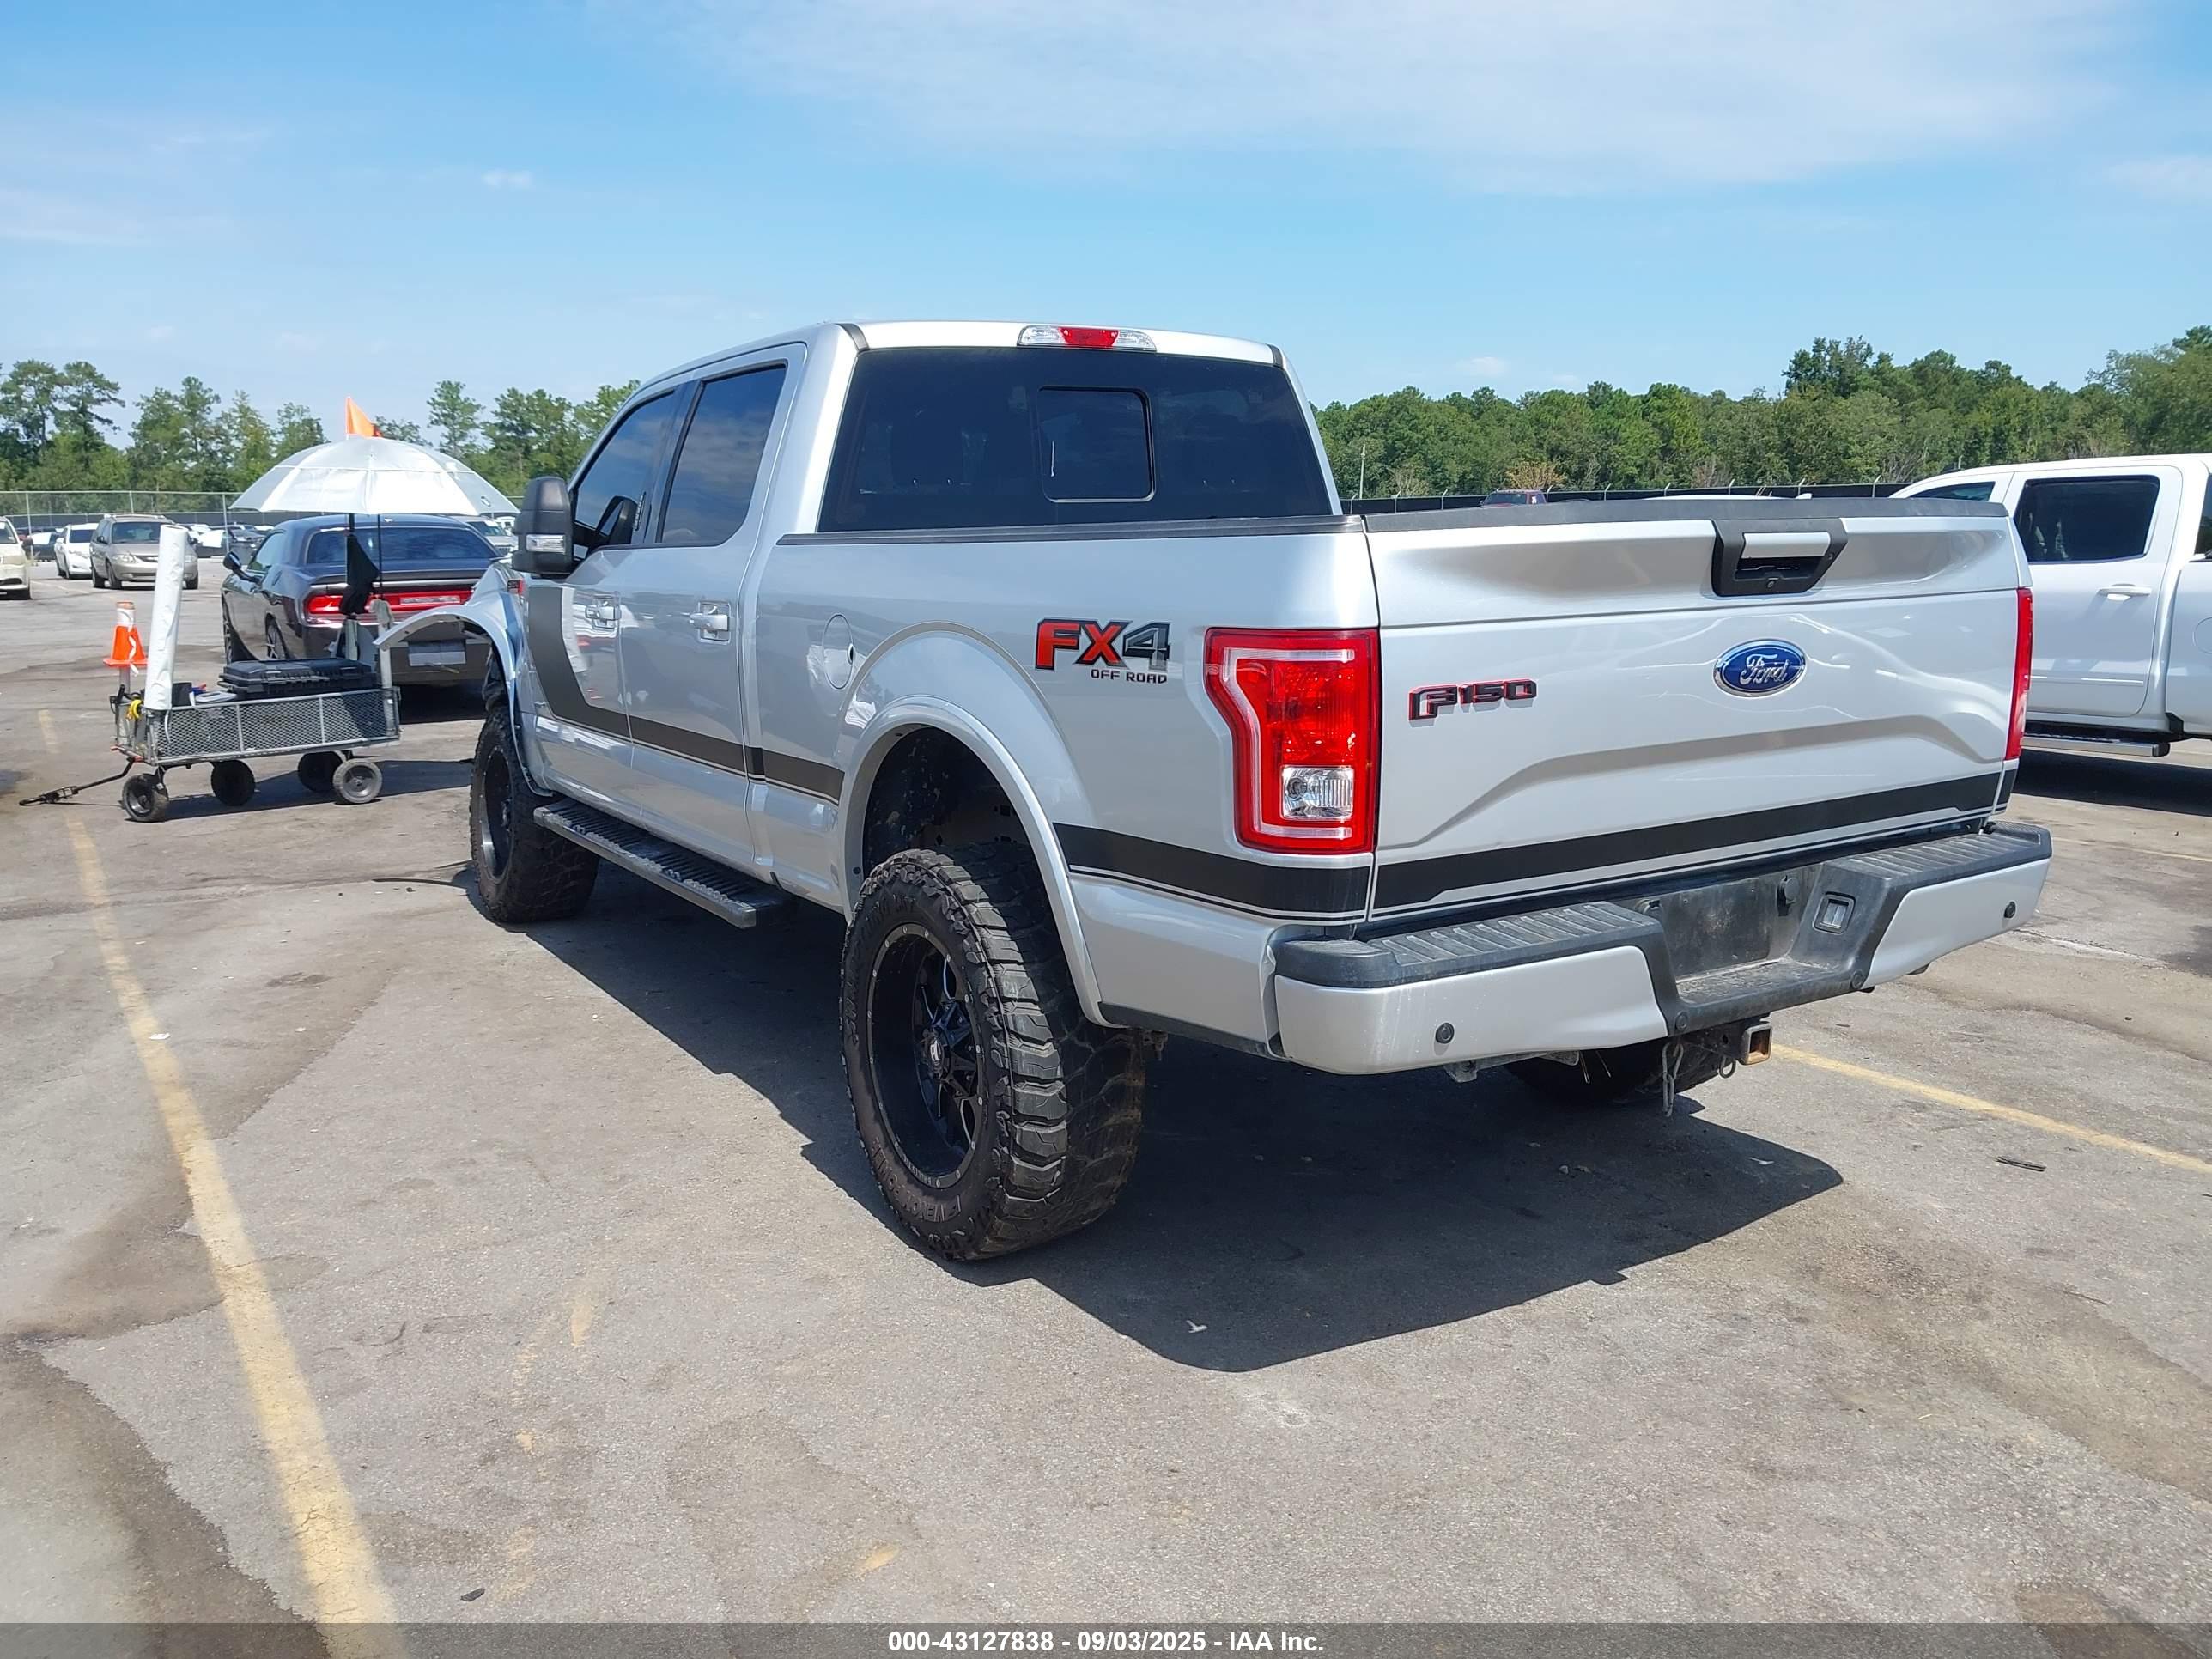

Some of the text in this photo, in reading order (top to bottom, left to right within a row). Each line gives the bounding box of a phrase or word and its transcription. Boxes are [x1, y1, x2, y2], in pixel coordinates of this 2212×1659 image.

[1035, 617, 1170, 671] FX4
[1091, 669, 1168, 684] OFF ROAD
[1740, 653, 1790, 685] Ford
